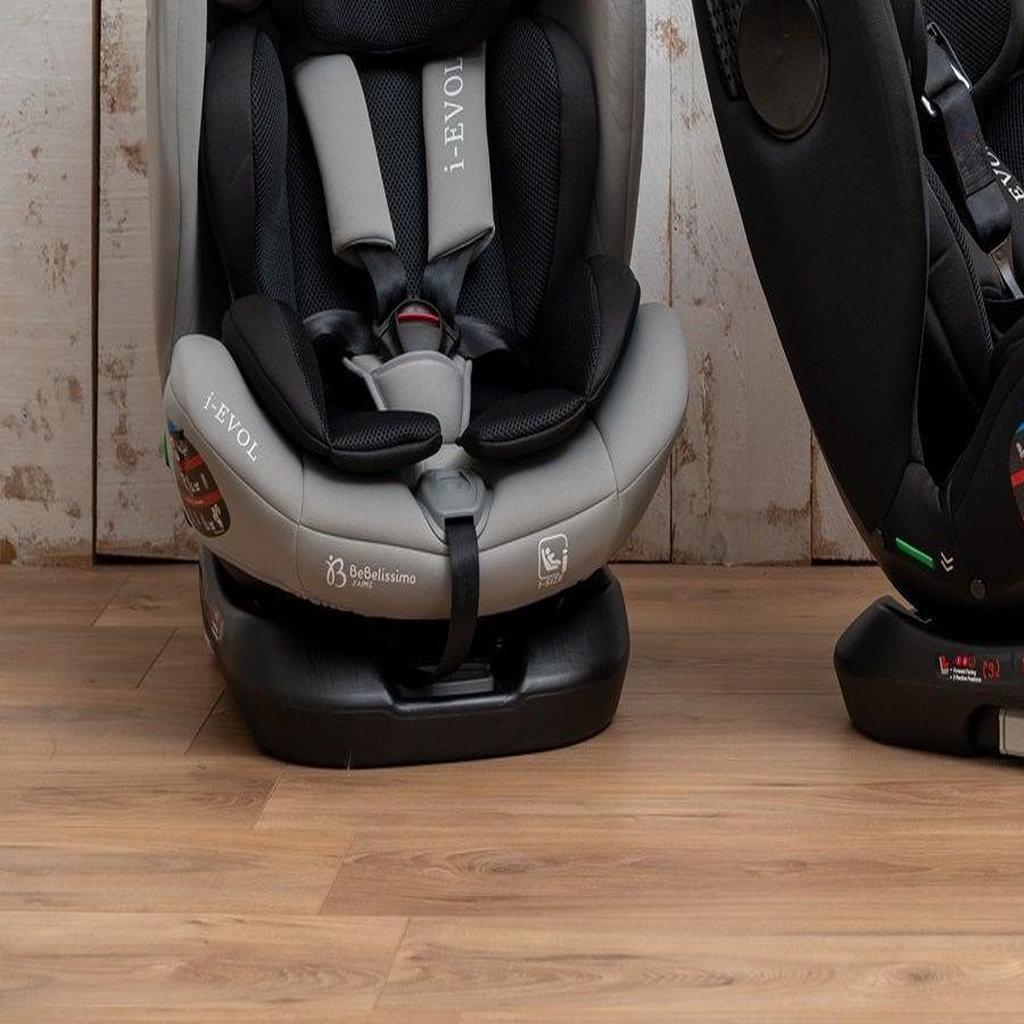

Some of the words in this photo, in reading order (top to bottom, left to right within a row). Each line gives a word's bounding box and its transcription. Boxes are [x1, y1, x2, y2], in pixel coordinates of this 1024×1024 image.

[443, 57, 465, 173] i-EVOL
[203, 391, 258, 462] i-EVOL
[349, 564, 417, 585] BeBelissimo
